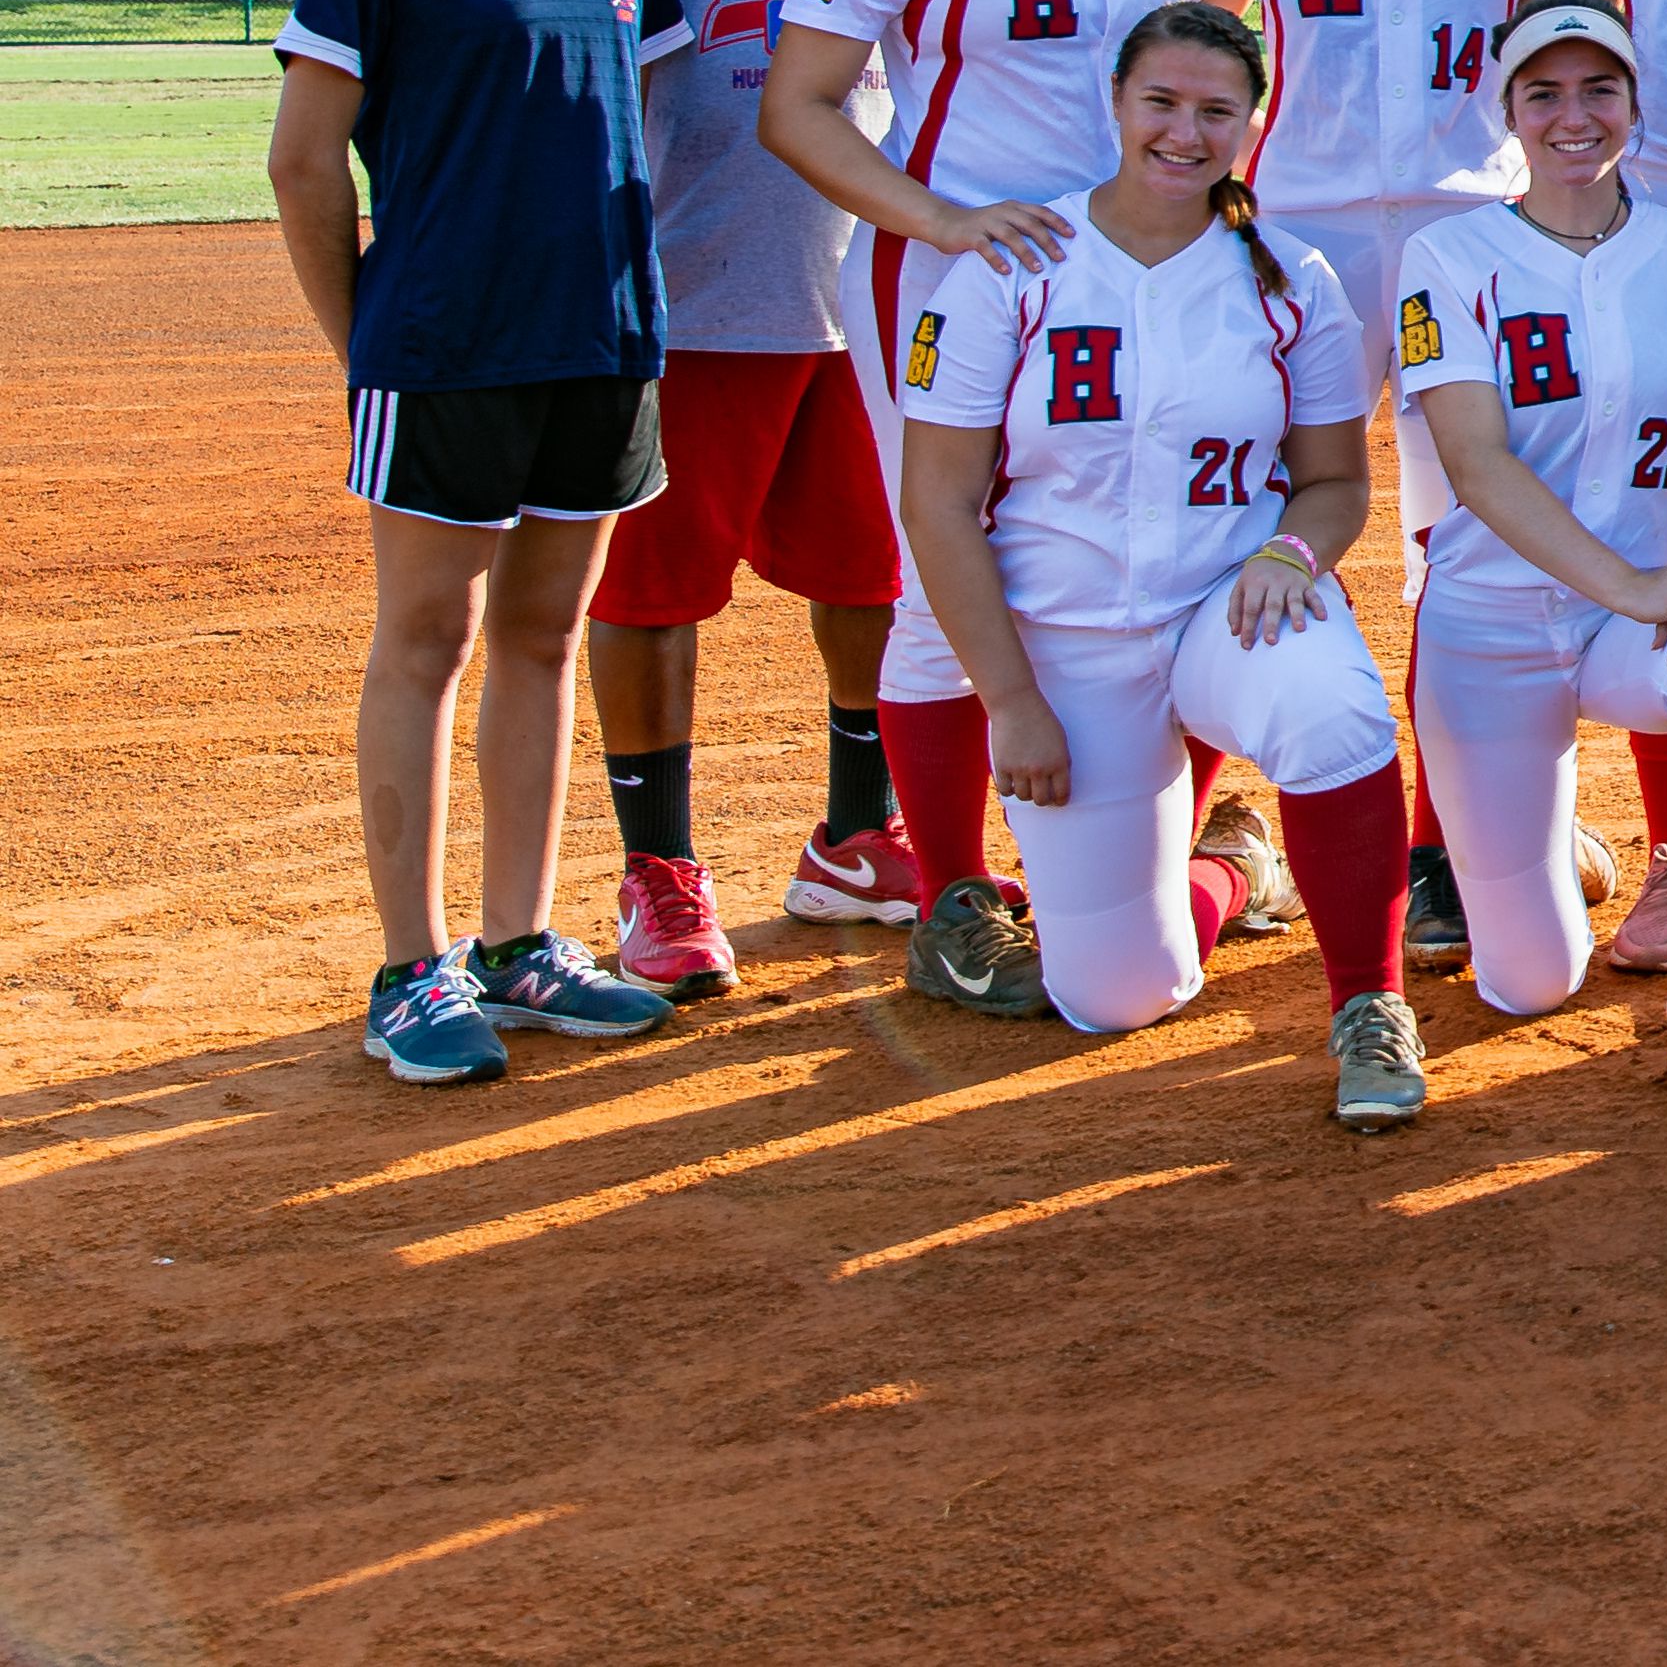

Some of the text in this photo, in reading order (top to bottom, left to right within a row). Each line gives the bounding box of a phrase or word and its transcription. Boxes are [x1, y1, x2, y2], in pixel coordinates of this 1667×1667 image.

[1431, 22, 1484, 94] 14
[1047, 325, 1123, 425] H
[1498, 310, 1582, 410] H
[1187, 436, 1253, 507] 21
